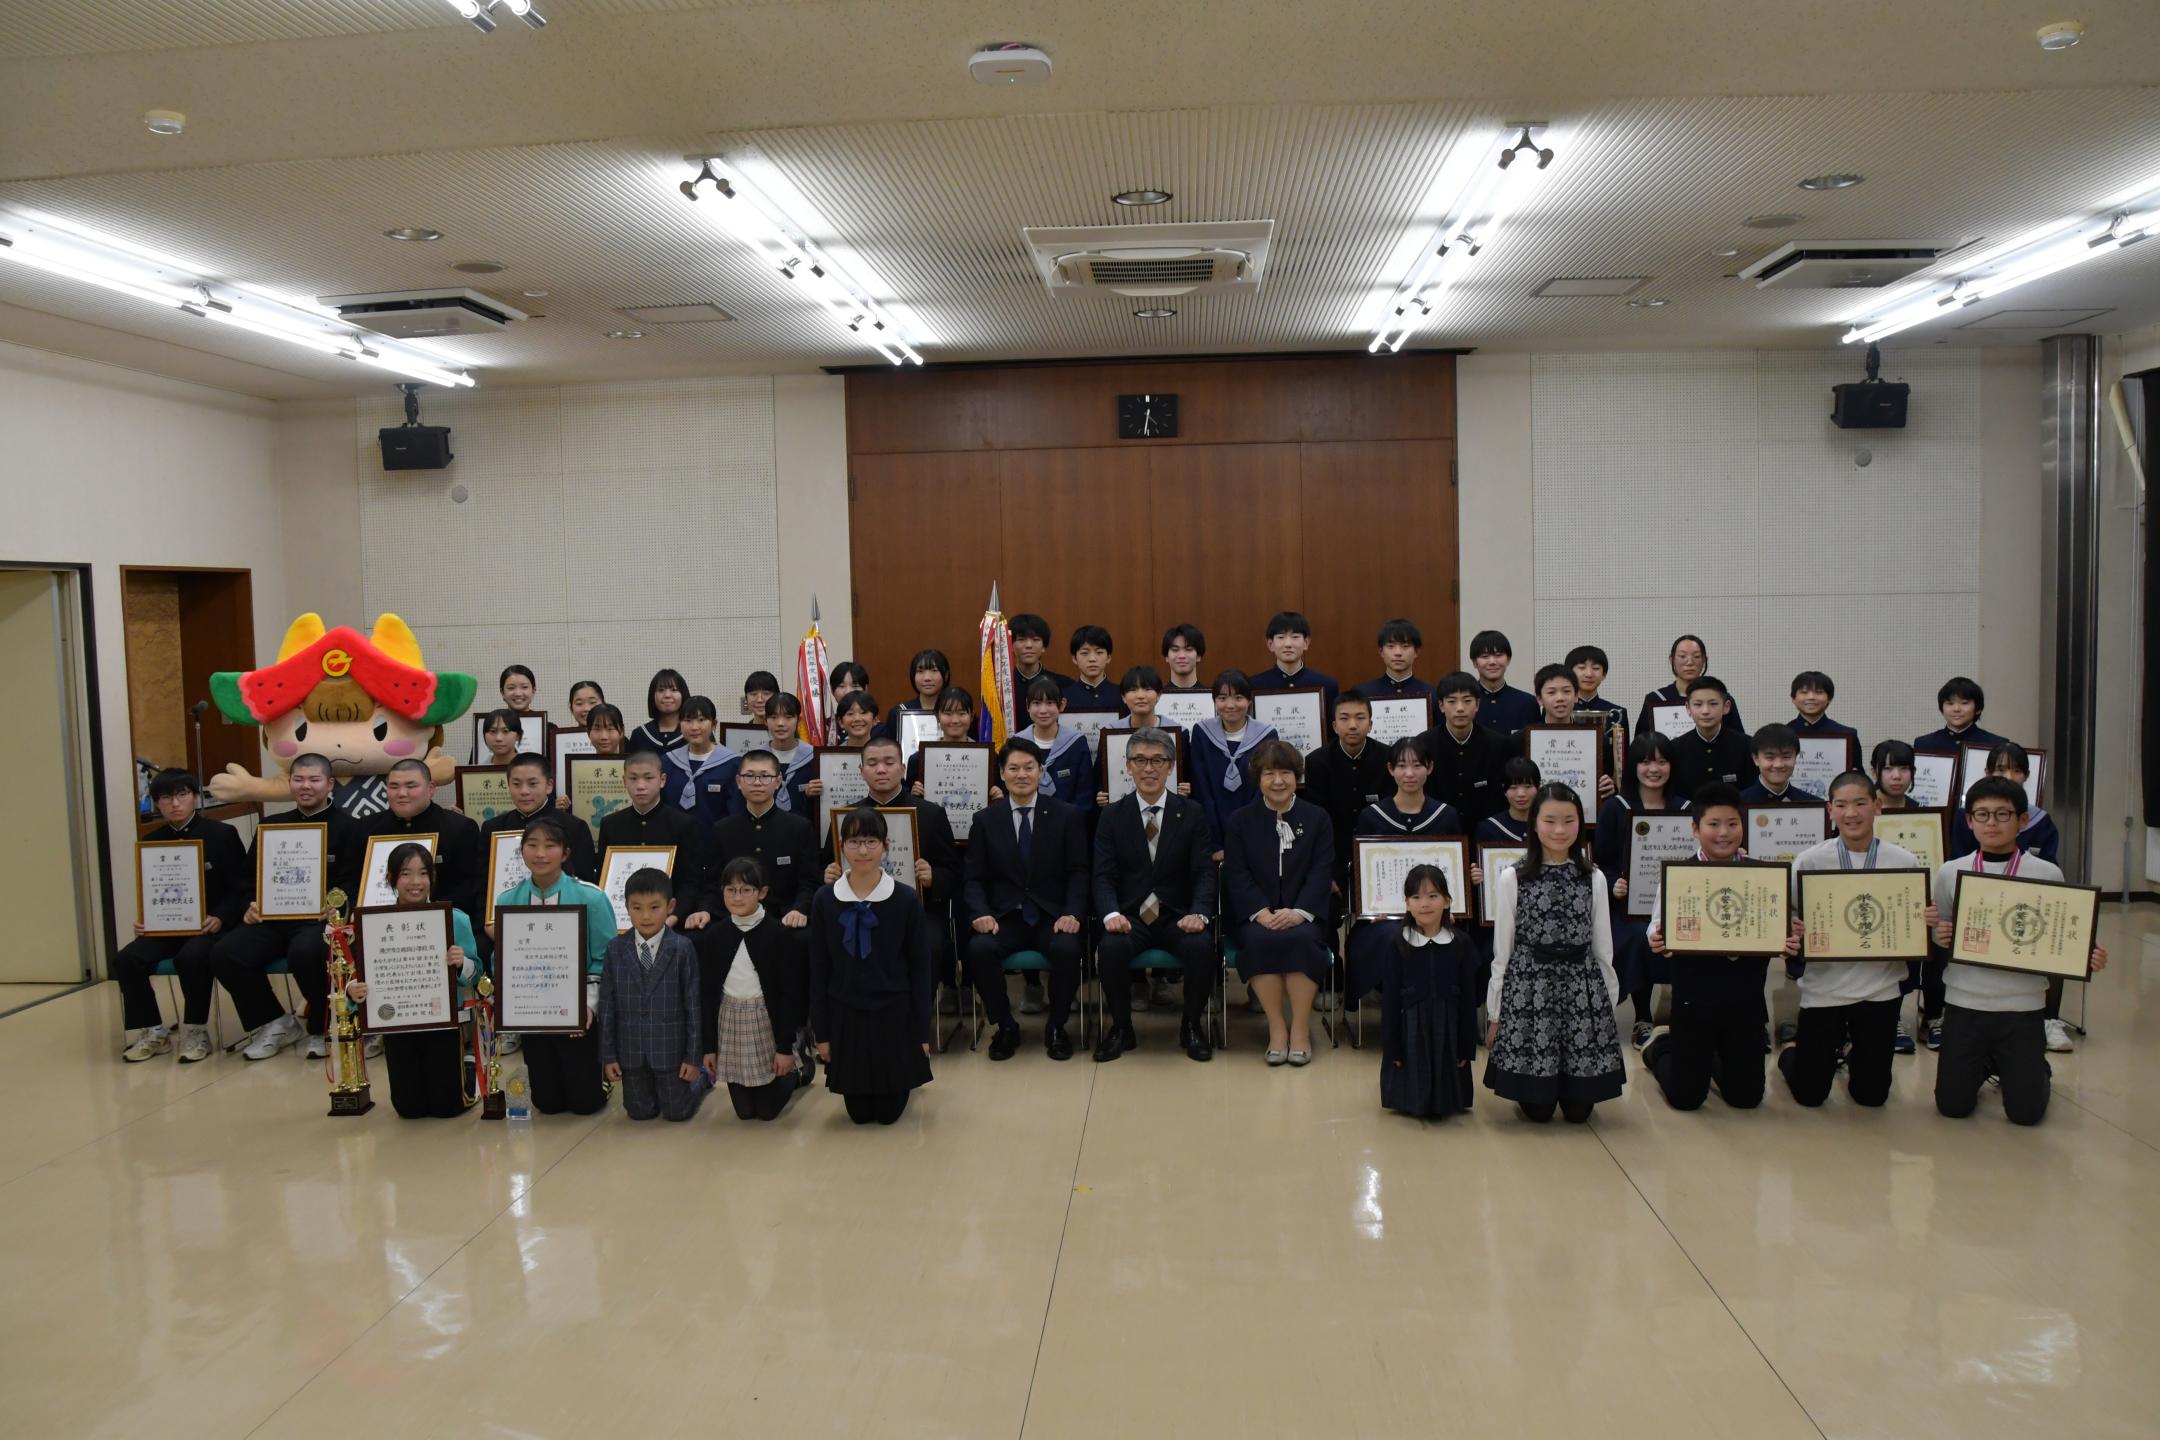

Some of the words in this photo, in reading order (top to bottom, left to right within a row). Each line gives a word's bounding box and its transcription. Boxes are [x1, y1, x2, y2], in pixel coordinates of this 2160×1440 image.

[1171, 701, 1196, 710] 賞状
[1274, 705, 1300, 715] 賞状
[1384, 705, 1408, 714] 賞状
[1075, 722, 1100, 732] 賞状
[1548, 739, 1576, 748] 賞状
[944, 753, 969, 761] 賞状
[593, 767, 619, 778] 栄光
[1774, 817, 1799, 826] 賞状
[1656, 825, 1681, 833] 賞状
[280, 840, 304, 849] 賞状
[1769, 893, 1779, 918] 賞状
[1913, 901, 1922, 920] 賞状
[385, 922, 426, 933] 表彰状
[527, 922, 554, 932] 賞状
[2067, 914, 2080, 941] 賞状
